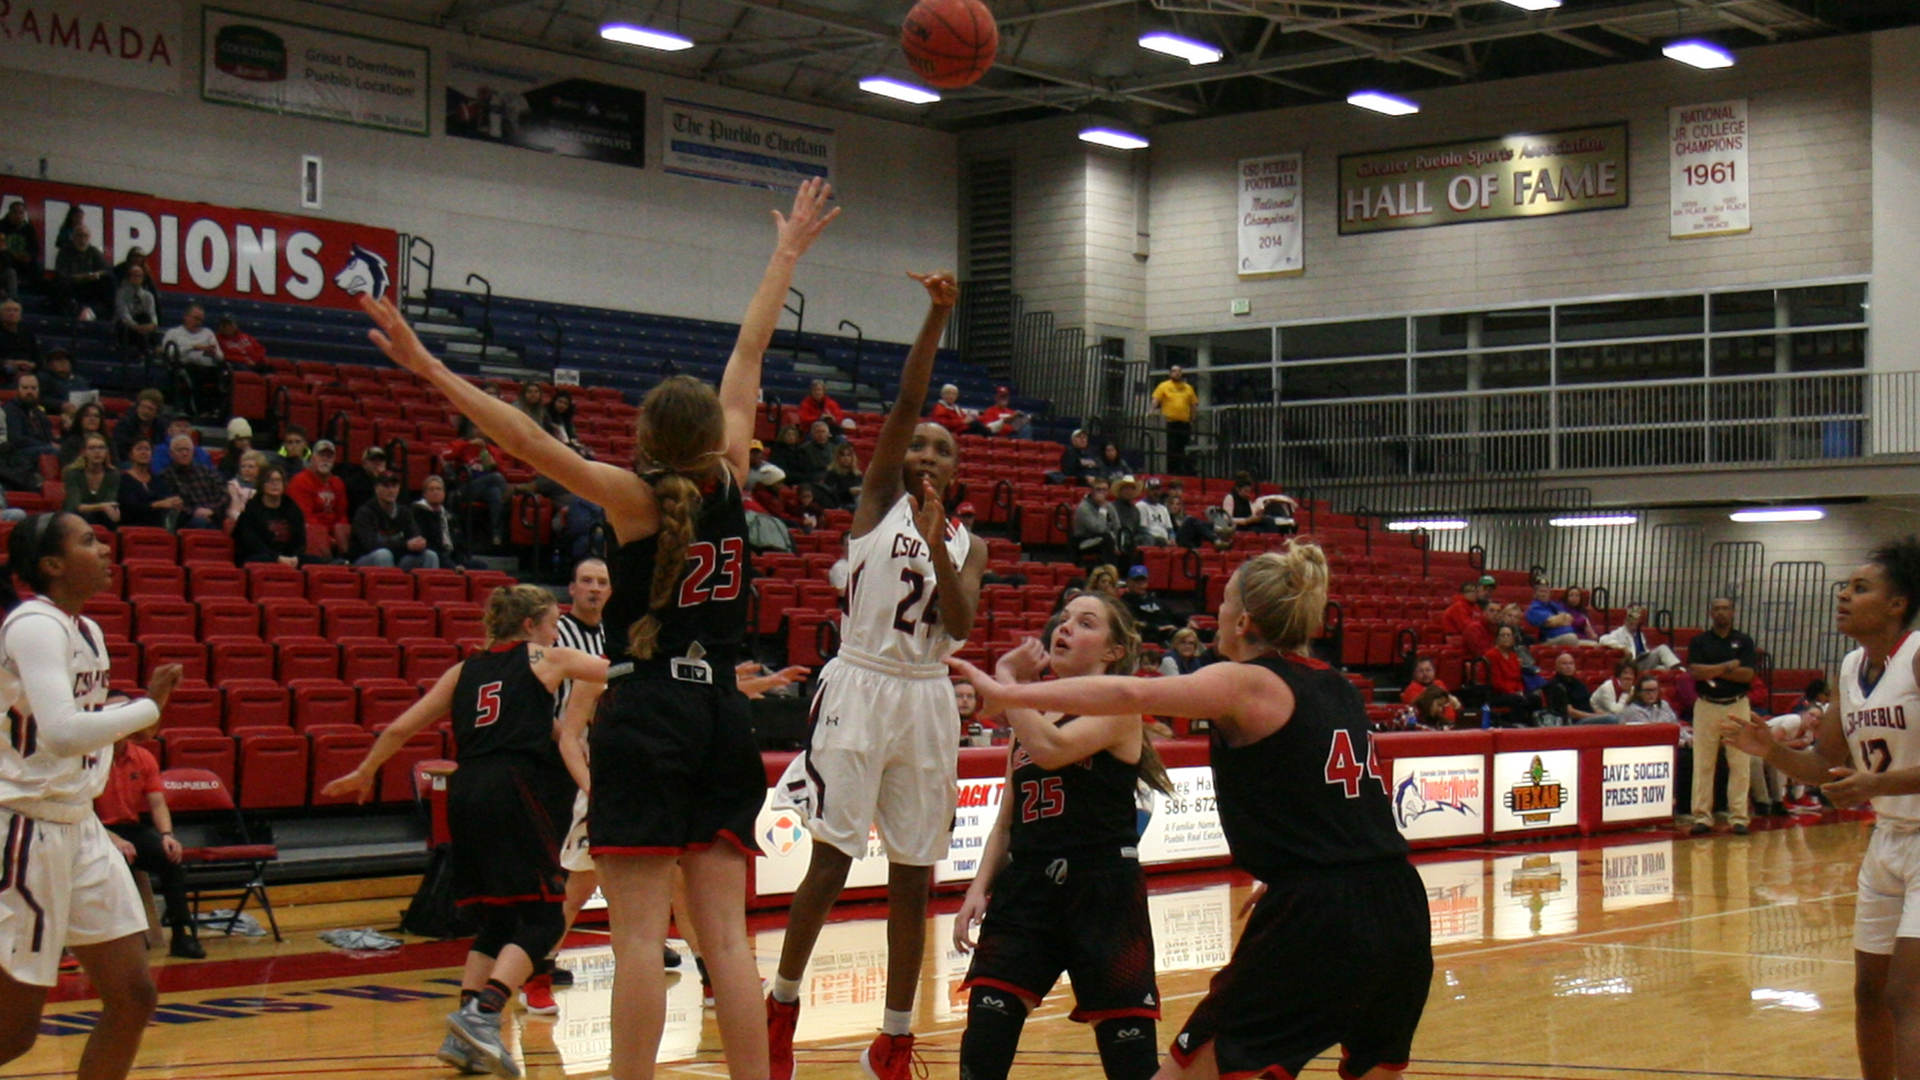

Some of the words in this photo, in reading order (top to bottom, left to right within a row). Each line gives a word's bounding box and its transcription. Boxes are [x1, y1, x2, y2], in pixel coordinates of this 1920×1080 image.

[0, 0, 172, 67] RAMADA
[305, 49, 342, 66] Great
[347, 55, 415, 78] Downtown
[305, 68, 351, 87] Pueblo
[1680, 105, 1736, 124] NATIONAL
[672, 112, 703, 136] The
[709, 118, 761, 146] Pueblo
[765, 131, 828, 158] Chieftain
[1672, 126, 1686, 142] JR
[1692, 120, 1746, 139] COLLEGE
[1675, 136, 1743, 157] CHAMPIONS
[1357, 159, 1410, 178] Greater
[1415, 152, 1463, 171] Pueblo
[1468, 147, 1514, 169] Sports
[1518, 137, 1607, 160] Association
[1244, 174, 1297, 192] FOOTBALL
[1682, 160, 1736, 187] 1961
[1345, 180, 1433, 223] HALL
[1447, 172, 1498, 214] OF
[1512, 160, 1618, 206] FAME
[1250, 193, 1298, 212] National
[1243, 212, 1297, 228] Champions
[1258, 234, 1283, 250] 2014
[678, 536, 744, 608] 23
[474, 680, 503, 728] 5
[1602, 764, 1631, 782] DAVE
[1633, 761, 1670, 780] SOCIER
[164, 780, 219, 790] CSU-PUEBLO
[1196, 776, 1212, 791] Ha
[956, 784, 992, 808] ACK
[1021, 776, 1065, 824] 25
[1164, 796, 1217, 815] 586-872
[1513, 785, 1560, 811] TEXAS
[1605, 786, 1638, 807] PRESS
[1641, 785, 1666, 804] ROW
[1197, 820, 1216, 830] Name
[965, 836, 983, 848] CLUB
[1187, 832, 1201, 842] Real
[953, 859, 977, 872] TODAY!
